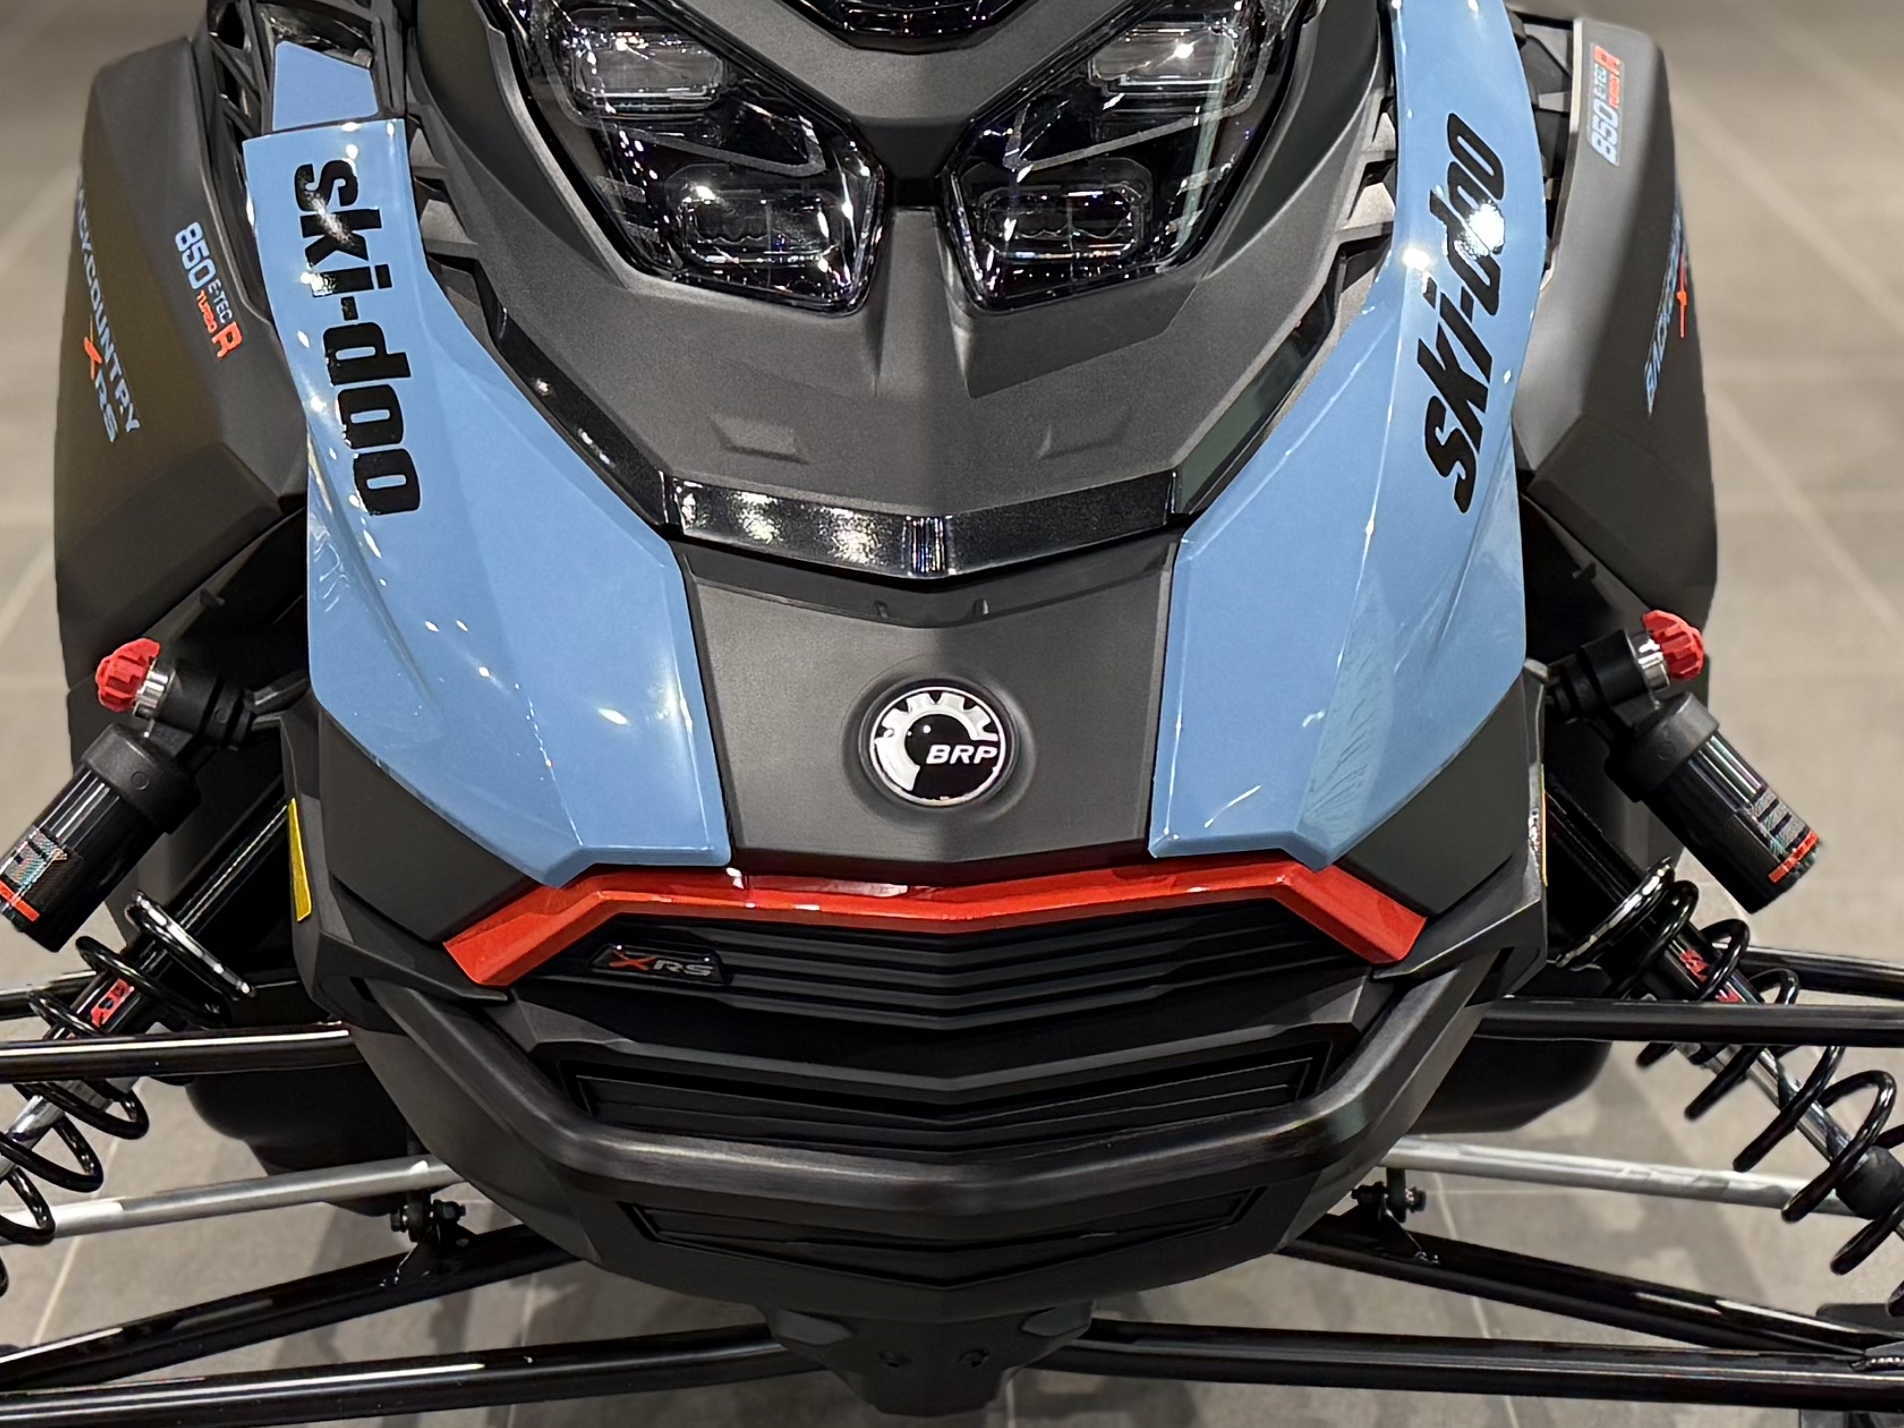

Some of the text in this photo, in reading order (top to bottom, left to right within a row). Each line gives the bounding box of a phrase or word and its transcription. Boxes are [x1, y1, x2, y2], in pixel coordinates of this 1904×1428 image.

[1591, 98, 1620, 167] 850
[175, 221, 243, 358] 850 E-TEC TURBO R
[294, 158, 422, 517] ski-doo
[1417, 112, 1506, 514] ski-doo
[925, 744, 998, 766] BRP
[607, 949, 714, 977] XRS
